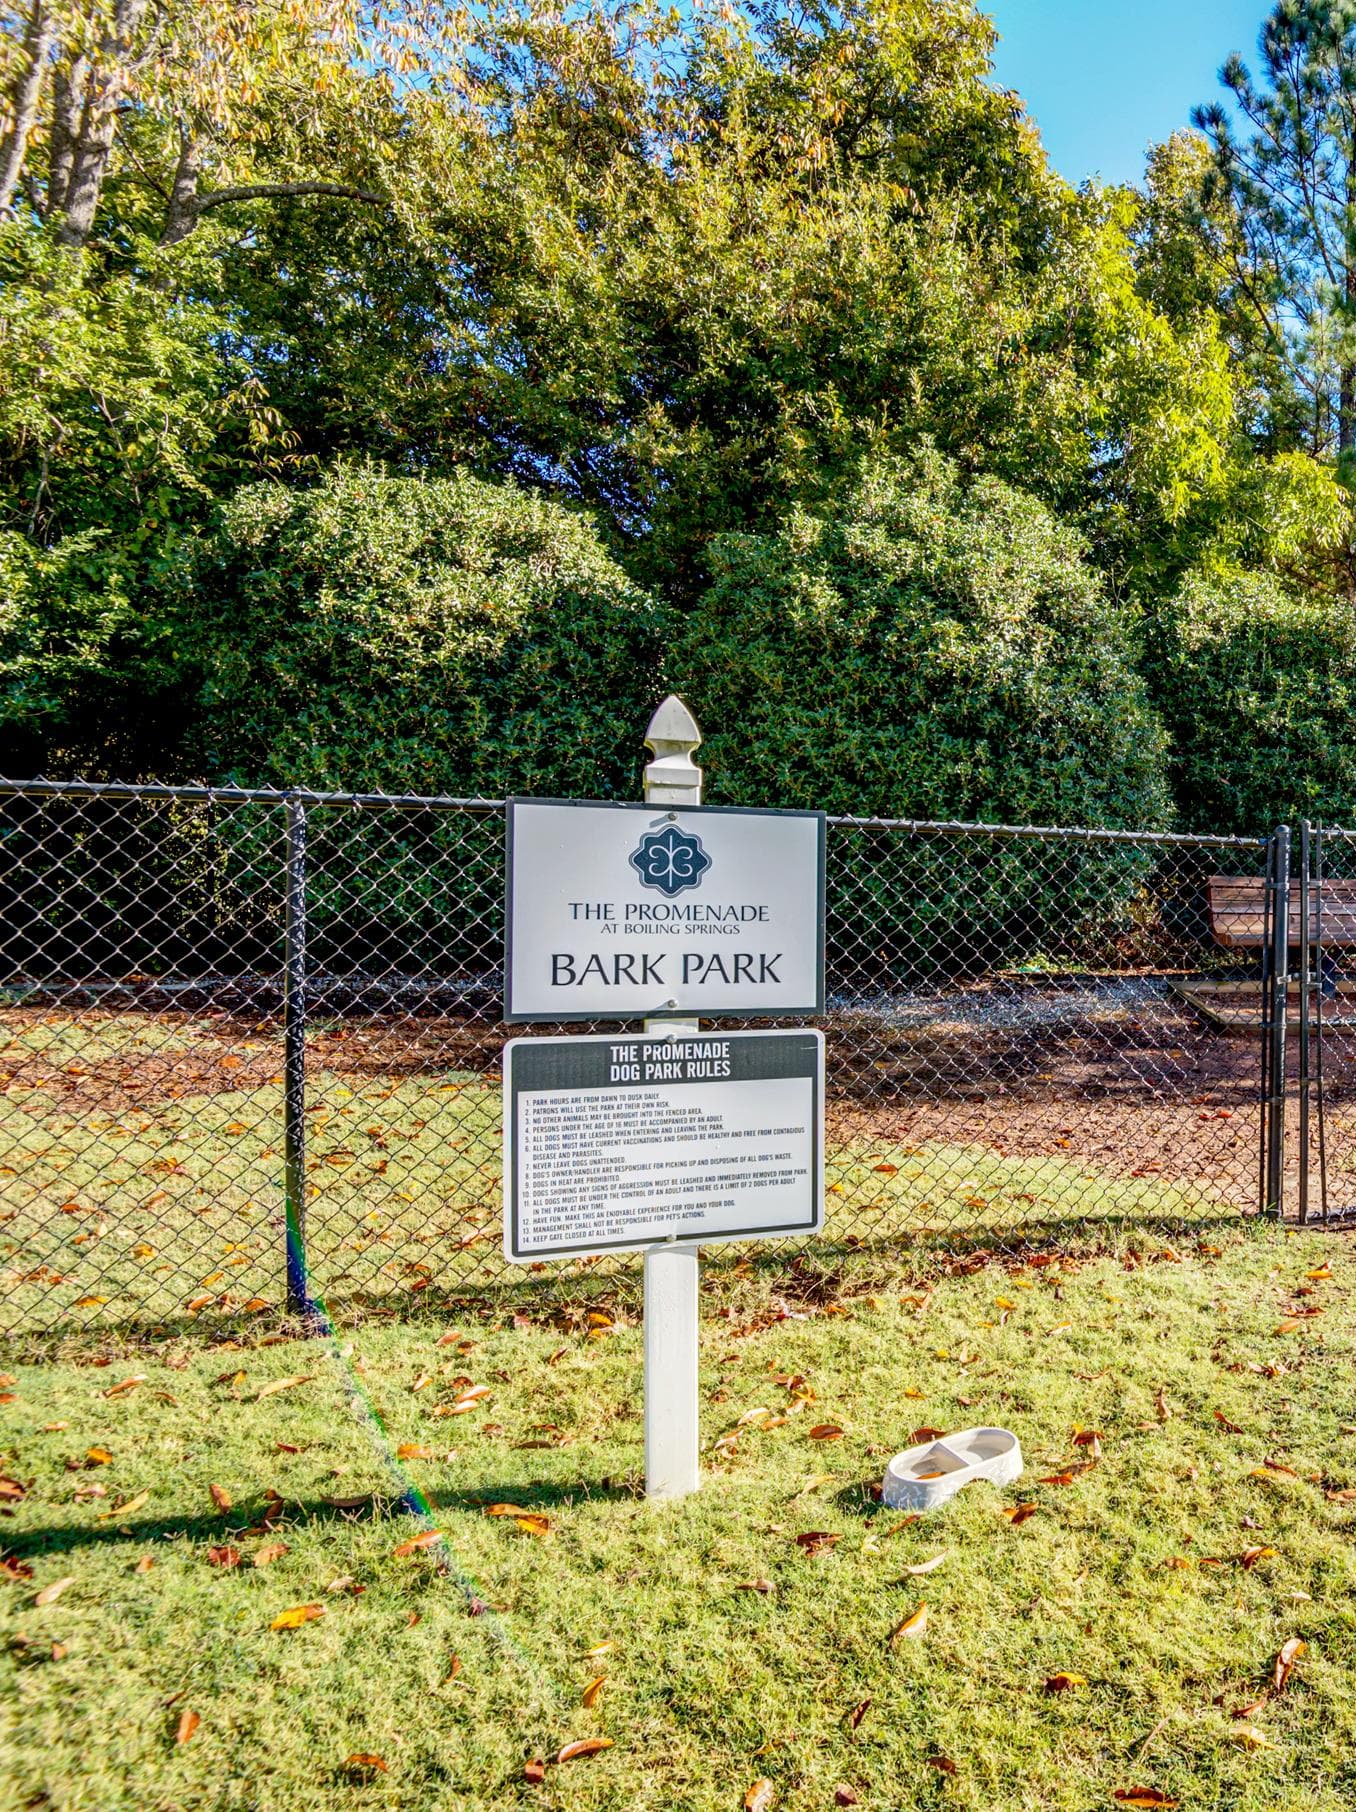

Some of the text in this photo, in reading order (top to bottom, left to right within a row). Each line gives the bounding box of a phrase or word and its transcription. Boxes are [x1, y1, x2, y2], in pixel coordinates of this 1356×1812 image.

[568, 903, 770, 922] THE PROMENADE
[600, 923, 741, 935] AT BOILING SPRINGS
[551, 953, 783, 986] BARK PARK
[610, 1042, 730, 1063] THE PROMENADE
[610, 1060, 731, 1081] DOG PARK RULES
[532, 1098, 548, 1106] PARK
[549, 1097, 570, 1105] HOURS
[571, 1096, 582, 1104] ARE
[628, 1093, 643, 1101] DUSK
[533, 1107, 559, 1115] PATRONS
[575, 1105, 587, 1113] USE
[588, 1104, 599, 1112] THE
[625, 1102, 640, 1110] THEIR
[642, 1101, 655, 1109] OWN
[543, 1115, 562, 1123] OTHER
[563, 1114, 589, 1122] ANIMALS
[590, 1113, 602, 1121] MAY
[612, 1111, 638, 1119] BROUGHT
[640, 1110, 653, 1118] INTO
[665, 1108, 687, 1116] FENCED
[533, 1124, 560, 1133] PERSONS
[561, 1123, 581, 1131] UNDER
[623, 1120, 639, 1128] MUST
[649, 1117, 688, 1126] ACCOMPANIED
[689, 1116, 696, 1124] BY
[544, 1133, 561, 1142] DOGS
[562, 1132, 578, 1140] MUST
[588, 1130, 614, 1139] LEASHED
[615, 1129, 632, 1137] WHEN
[633, 1127, 660, 1136] ENTERING
[674, 1125, 697, 1133] LEAVING
[698, 1124, 708, 1132] THE
[533, 1143, 542, 1151] ALL
[545, 1142, 560, 1150] DOGS
[562, 1141, 578, 1149] MUST
[579, 1140, 594, 1148] HAVE
[595, 1138, 621, 1147] CURRENT
[623, 1136, 663, 1145] VACCINATIONS
[676, 1134, 698, 1142] SHOULD
[708, 1131, 730, 1140] HEALTHY
[773, 1127, 805, 1135] CONTAGIOUS
[533, 1152, 557, 1161] DISEASE
[558, 1151, 571, 1159] AND
[533, 1161, 552, 1170] NEVER
[553, 1160, 570, 1168] LEAVE
[572, 1159, 588, 1167] DOGS
[614, 1163, 651, 1172] RESPONSIBLE
[653, 1162, 664, 1170] FOR
[665, 1160, 688, 1169] PICKING
[710, 1156, 739, 1165] DISPOSING
[747, 1155, 757, 1163] ALL
[533, 1180, 549, 1188] DOGS
[550, 1179, 557, 1187] IN
[558, 1178, 573, 1186] HEAT
[573, 1177, 584, 1185] ARE
[533, 1188, 549, 1197] DOGS
[550, 1186, 577, 1195] SHOWING
[579, 1185, 590, 1193] ANY
[591, 1184, 609, 1192] SIGNS
[619, 1180, 654, 1190] AGGRESSION
[655, 1179, 670, 1187] MUST
[679, 1176, 704, 1185] LEASHED
[704, 1175, 716, 1183] AND
[717, 1173, 751, 1182] IMMEDIATELY
[752, 1171, 777, 1179] REMOVED
[778, 1169, 793, 1177] FROM
[533, 1198, 542, 1206] ALL
[545, 1196, 560, 1205] DOGS
[562, 1195, 578, 1203] MUST
[588, 1192, 608, 1201] UNDER
[621, 1189, 646, 1198] CONTROL
[665, 1187, 682, 1195] ADULT
[696, 1184, 712, 1192] THERE
[725, 1182, 739, 1190] LIMIT
[780, 1177, 796, 1185] ADULT
[533, 1216, 548, 1224] HAVE
[565, 1213, 580, 1221] MAKE
[582, 1212, 595, 1220] THIS
[606, 1208, 636, 1218] ENJOYABLE
[637, 1205, 670, 1215] EXPERIENCE
[672, 1204, 683, 1212] FOR
[684, 1203, 695, 1211] YOU
[696, 1202, 707, 1210] AND
[553, 1205, 569, 1213] PARK
[533, 1222, 573, 1233] MANAGEMENT
[574, 1221, 591, 1229] SHALL
[593, 1220, 605, 1228] NOT
[615, 1215, 652, 1226] RESPONSIBLE
[654, 1214, 665, 1222] FOR
[533, 1234, 548, 1243] KEEP
[549, 1233, 563, 1241] GATE
[564, 1230, 587, 1240] CLOSED
[596, 1229, 605, 1237] ALL
